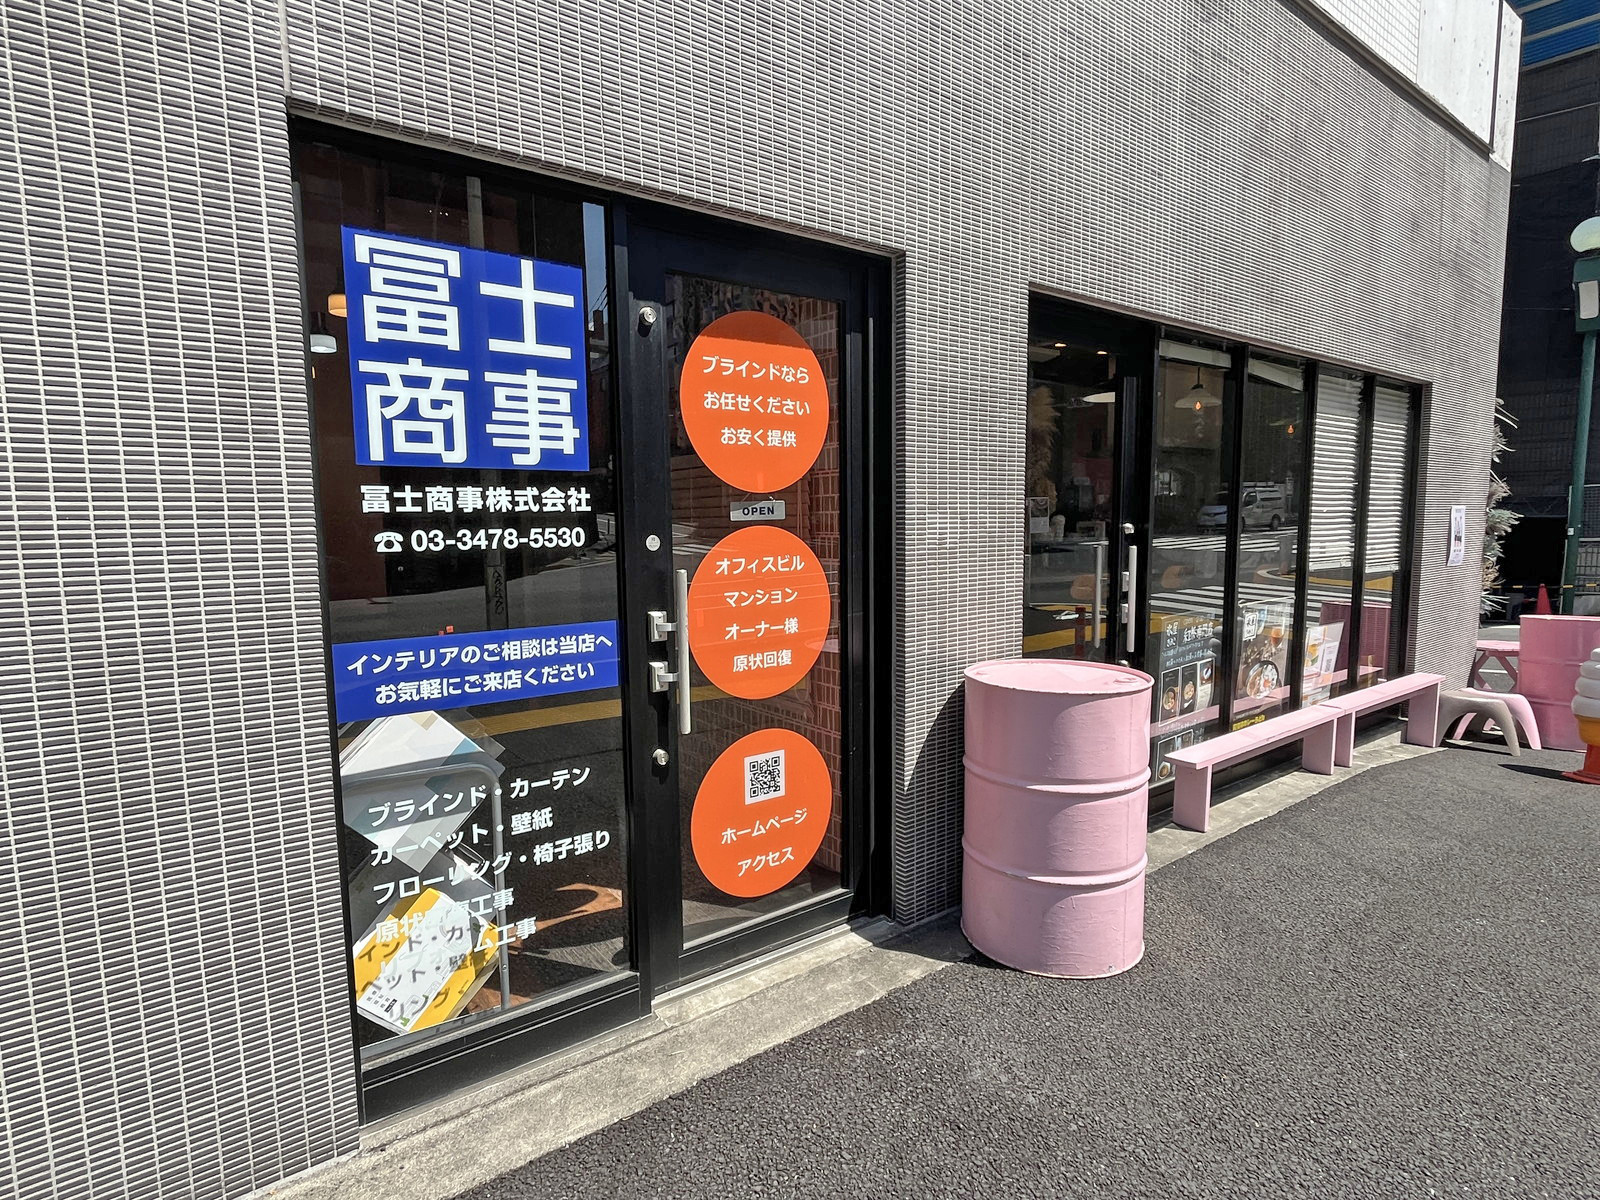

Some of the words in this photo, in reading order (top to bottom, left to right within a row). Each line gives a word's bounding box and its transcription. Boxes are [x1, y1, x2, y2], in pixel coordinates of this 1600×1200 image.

[702, 355, 810, 384] ブラインドなら
[358, 357, 580, 466] 商事
[703, 390, 811, 416] お任せください
[720, 426, 797, 448] お安く提供
[742, 505, 775, 516] OPEN
[410, 526, 586, 553] 03-3478-5530
[715, 554, 805, 576] オフィスビル
[723, 587, 799, 608] マンション
[724, 617, 799, 641] オーナー様
[346, 633, 614, 676] インテリアのご相談は当店へ
[732, 649, 793, 673] 原状回復
[374, 662, 596, 705] お気軽にご来店ください
[368, 767, 591, 828] ブラインド・カーテン
[370, 806, 554, 868] カーペット・壁紙
[721, 807, 808, 845] ホームページ
[373, 830, 611, 905] フローリング・椅子張り
[737, 846, 795, 877] アクセス
